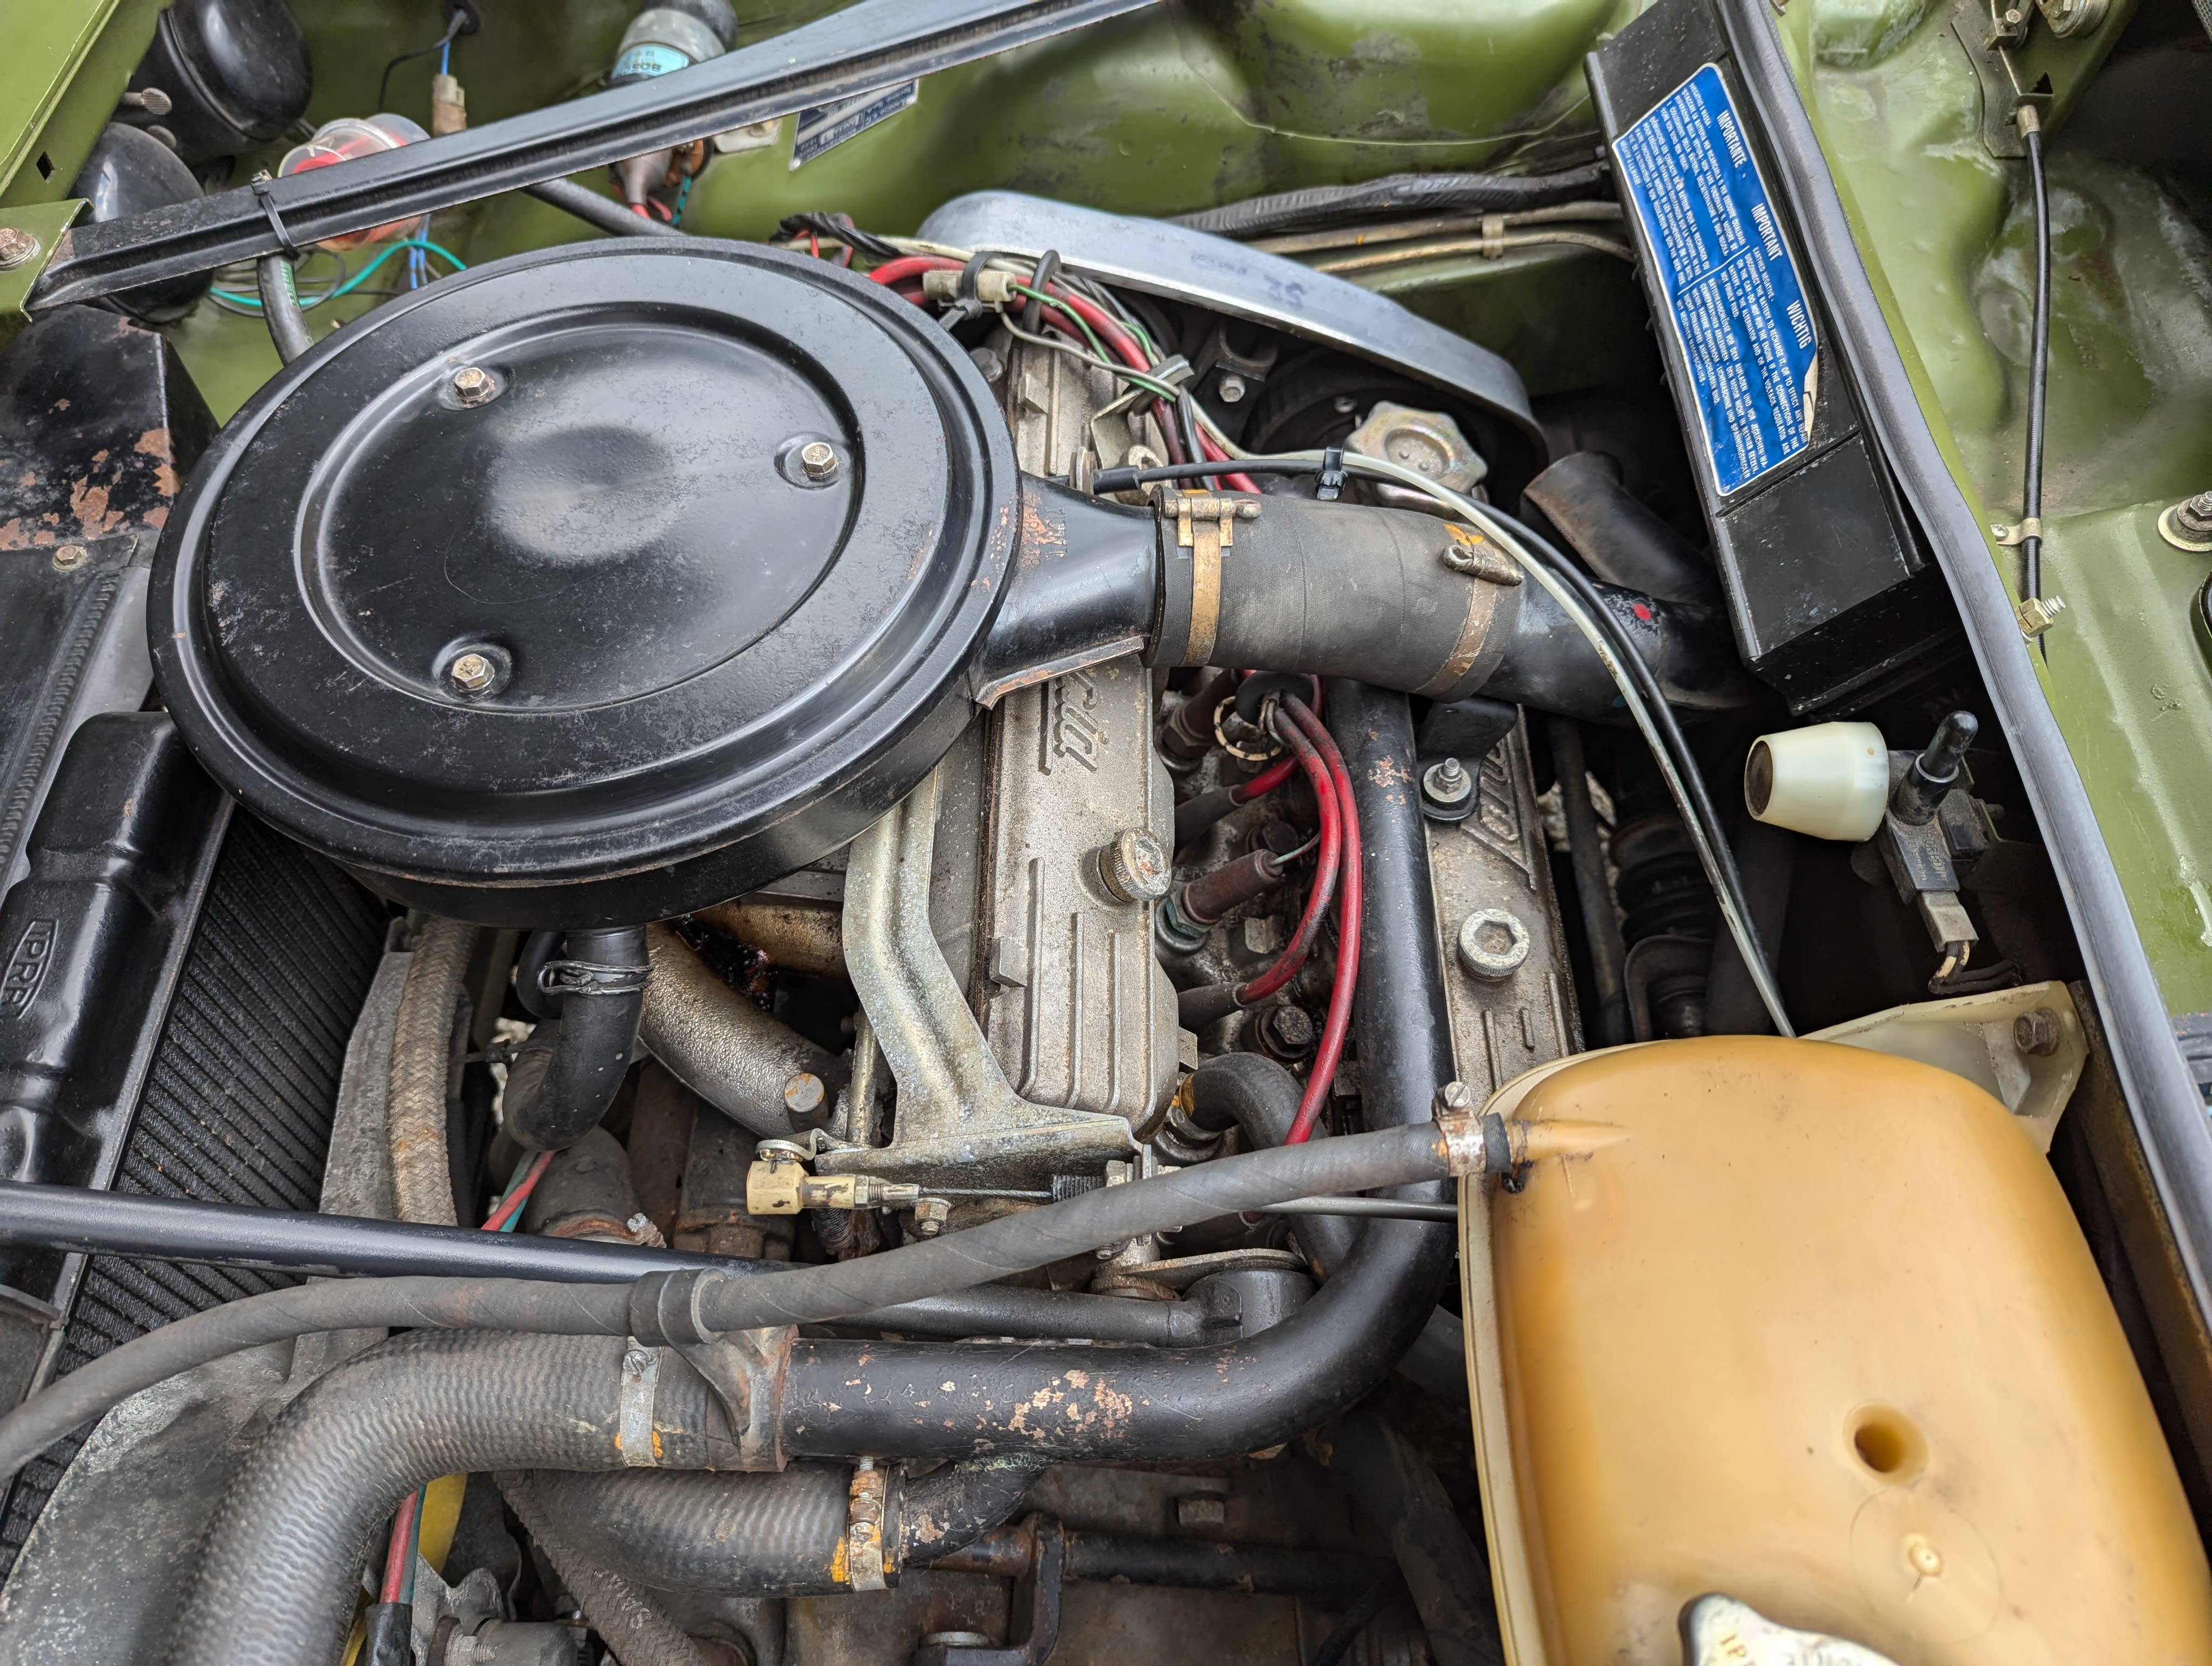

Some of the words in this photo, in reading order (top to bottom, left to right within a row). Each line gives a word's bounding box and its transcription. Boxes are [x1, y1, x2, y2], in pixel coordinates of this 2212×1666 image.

[1674, 94, 1690, 124] RIPARAZIONE
[1686, 123, 1696, 139] SULLA
[1700, 159, 1709, 172] NON
[1705, 171, 1714, 185] FARE
[1709, 184, 1724, 214] FUNZIONARE
[1715, 109, 1747, 169] IMPORTANTE
[1751, 201, 1783, 262] IMPORTANT
[1786, 299, 1812, 349] WICHTIG
[1722, 220, 1734, 242] MOTORE
[1730, 242, 1738, 251] SE
[1736, 258, 1744, 269] ON
[1752, 246, 1766, 272] EARTHED
[1727, 264, 1740, 290] BATTERY,
[1739, 268, 1747, 280] THE
[1744, 252, 1760, 286] DISCONNECT
[1720, 270, 1728, 283] NOT
[1724, 282, 1734, 303] FIRMLY
[1735, 288, 1742, 298] OF
[1755, 285, 1764, 297] THE
[1683, 293, 1694, 312] NICHT
[1707, 277, 1731, 334] BATTERIEANSCHLÜSSE
[1738, 296, 1746, 309] THE
[1750, 303, 1759, 317] NOT
[1758, 296, 1771, 321] BATTERY
[1679, 310, 1692, 340] NEGATIVEM
[1688, 311, 1703, 344] EINWANDFREI
[1741, 307, 1757, 342] ALTERNATOR
[1754, 316, 1763, 329] RUN
[1766, 319, 1774, 329] TO
[1725, 333, 1734, 347] VOR
[1758, 329, 1767, 341] THE
[1769, 328, 1783, 358] RECHARGE
[1729, 346, 1739, 362] DEM
[1752, 342, 1760, 356] AND
[1761, 341, 1773, 363] ENGINE
[1697, 343, 1716, 390] ANGESCHLOSSEN
[1757, 356, 1764, 366] OF
[1768, 362, 1776, 370] IF
[1777, 357, 1786, 367] IT,
[1725, 365, 1734, 379] DEN
[1734, 362, 1747, 392] AUFLADEN
[1760, 366, 1769, 380] THE
[1771, 370, 1780, 383] THE
[1781, 365, 1790, 376] OR
[1715, 366, 1732, 409] LICHTMASCHINE
[1728, 377, 1740, 400] MOTOR
[1784, 376, 1793, 387] TO
[1742, 393, 1752, 407] UND
[1763, 378, 1777, 407] VOLTAGE
[1787, 386, 1799, 408] EFFECT
[1733, 399, 1744, 418] NICHT
[1774, 383, 1792, 426] CONNECTIONS
[1726, 408, 1735, 423] UND
[1738, 417, 1746, 426] IN
[1746, 407, 1756, 421] VOR
[1793, 408, 1803, 422] ANY
[1771, 406, 1786, 441] REGULATOR
[1787, 426, 1795, 437] OF
[1741, 426, 1753, 450] BETRIEB
[1750, 421, 1765, 454] JEGLICHEN
[1790, 436, 1799, 450] THE
[1730, 422, 1750, 479] SPANNUNGSREGLER
[1781, 441, 1790, 455] ARE
[1747, 450, 1759, 475] SETZEN,
